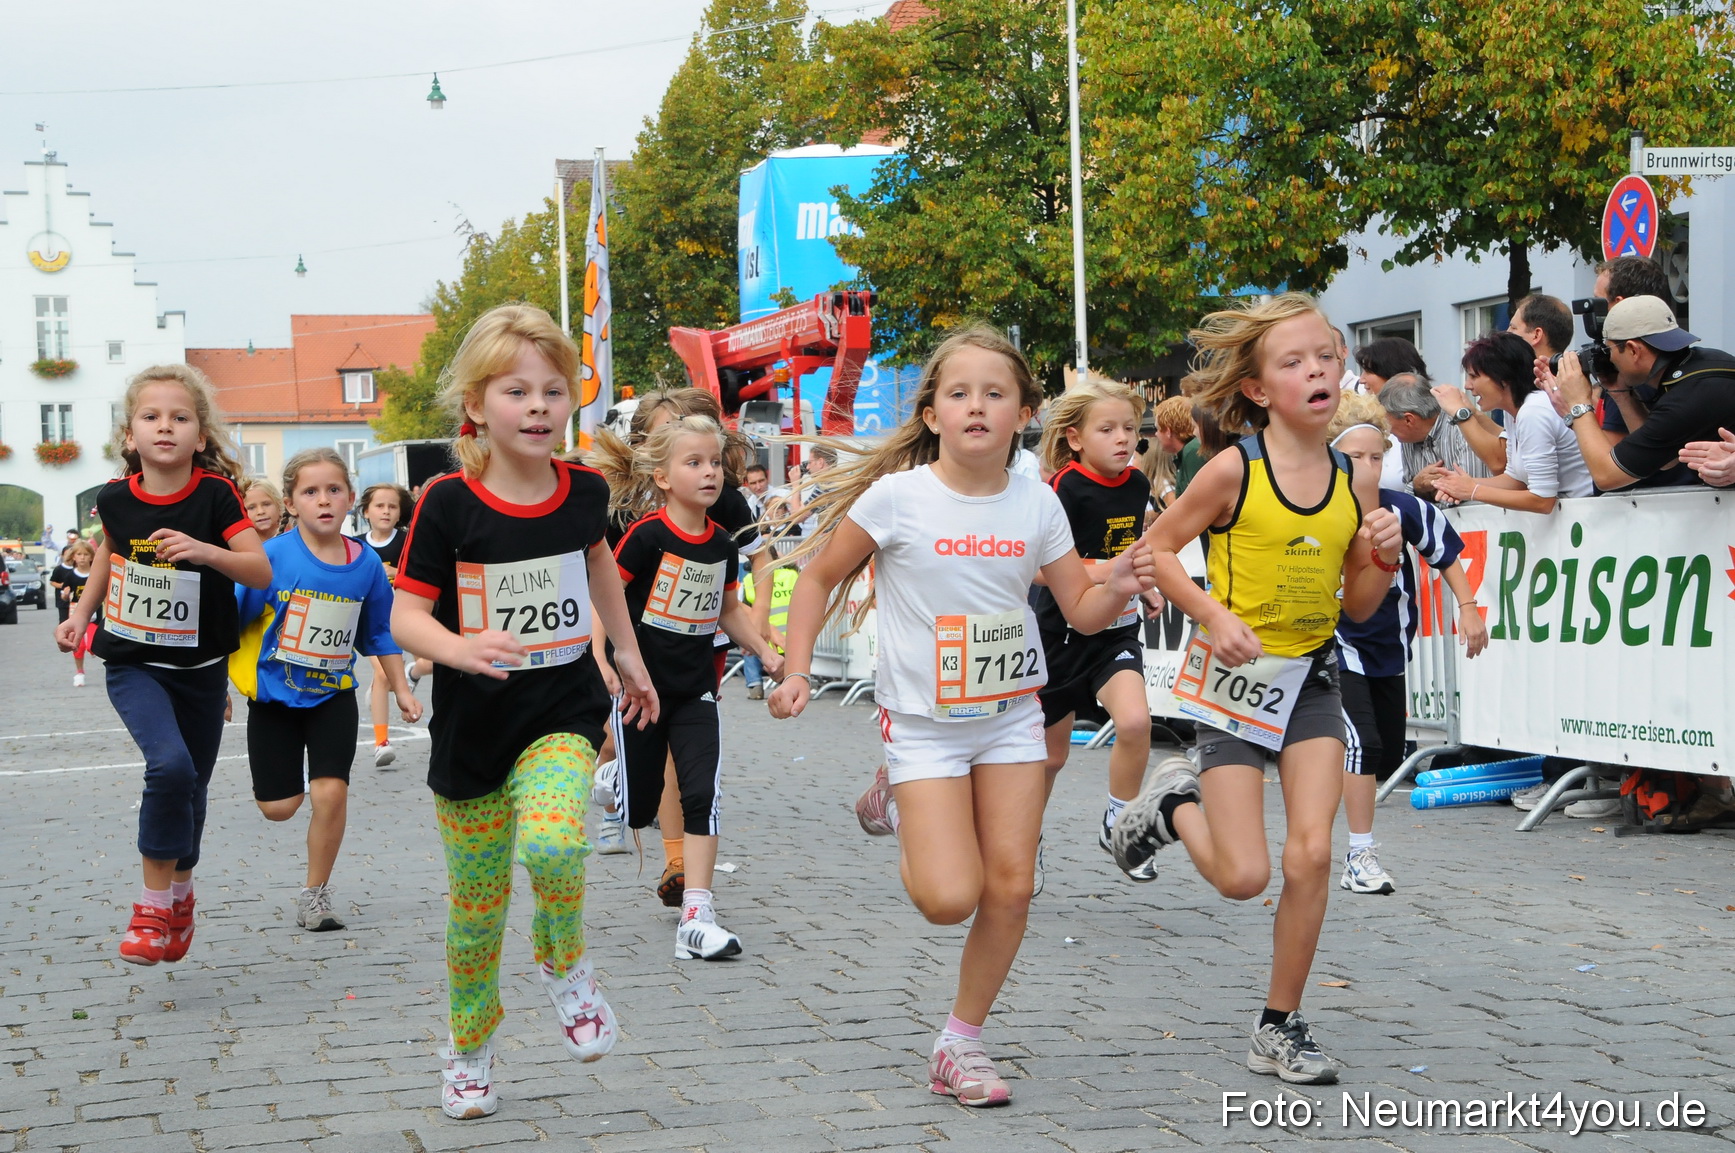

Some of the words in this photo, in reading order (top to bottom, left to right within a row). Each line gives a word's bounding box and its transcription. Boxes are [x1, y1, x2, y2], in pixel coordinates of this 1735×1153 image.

[934, 535, 1026, 557] adidas
[1285, 548, 1321, 557] skinfit
[127, 567, 171, 590] Hannah
[683, 567, 714, 586] Sidney
[1276, 565, 1287, 573] TV
[1286, 575, 1315, 584] Triathlon
[111, 583, 119, 597] K3
[496, 568, 555, 598] ALINA
[656, 580, 669, 593] K3
[1490, 522, 1713, 647] Reisen
[127, 593, 189, 621] 7120
[677, 589, 720, 612] 7126
[496, 598, 580, 635] 7269
[309, 626, 352, 648] 7304
[973, 624, 1024, 644] Luciana
[545, 642, 589, 659] PFLEIDERER
[1188, 653, 1202, 670] K3
[942, 656, 958, 671] K3
[974, 648, 1039, 684] 7122
[1143, 662, 1176, 689] werke
[1213, 667, 1285, 715] 7052
[1561, 718, 1715, 748] www.merz-reisen.com
